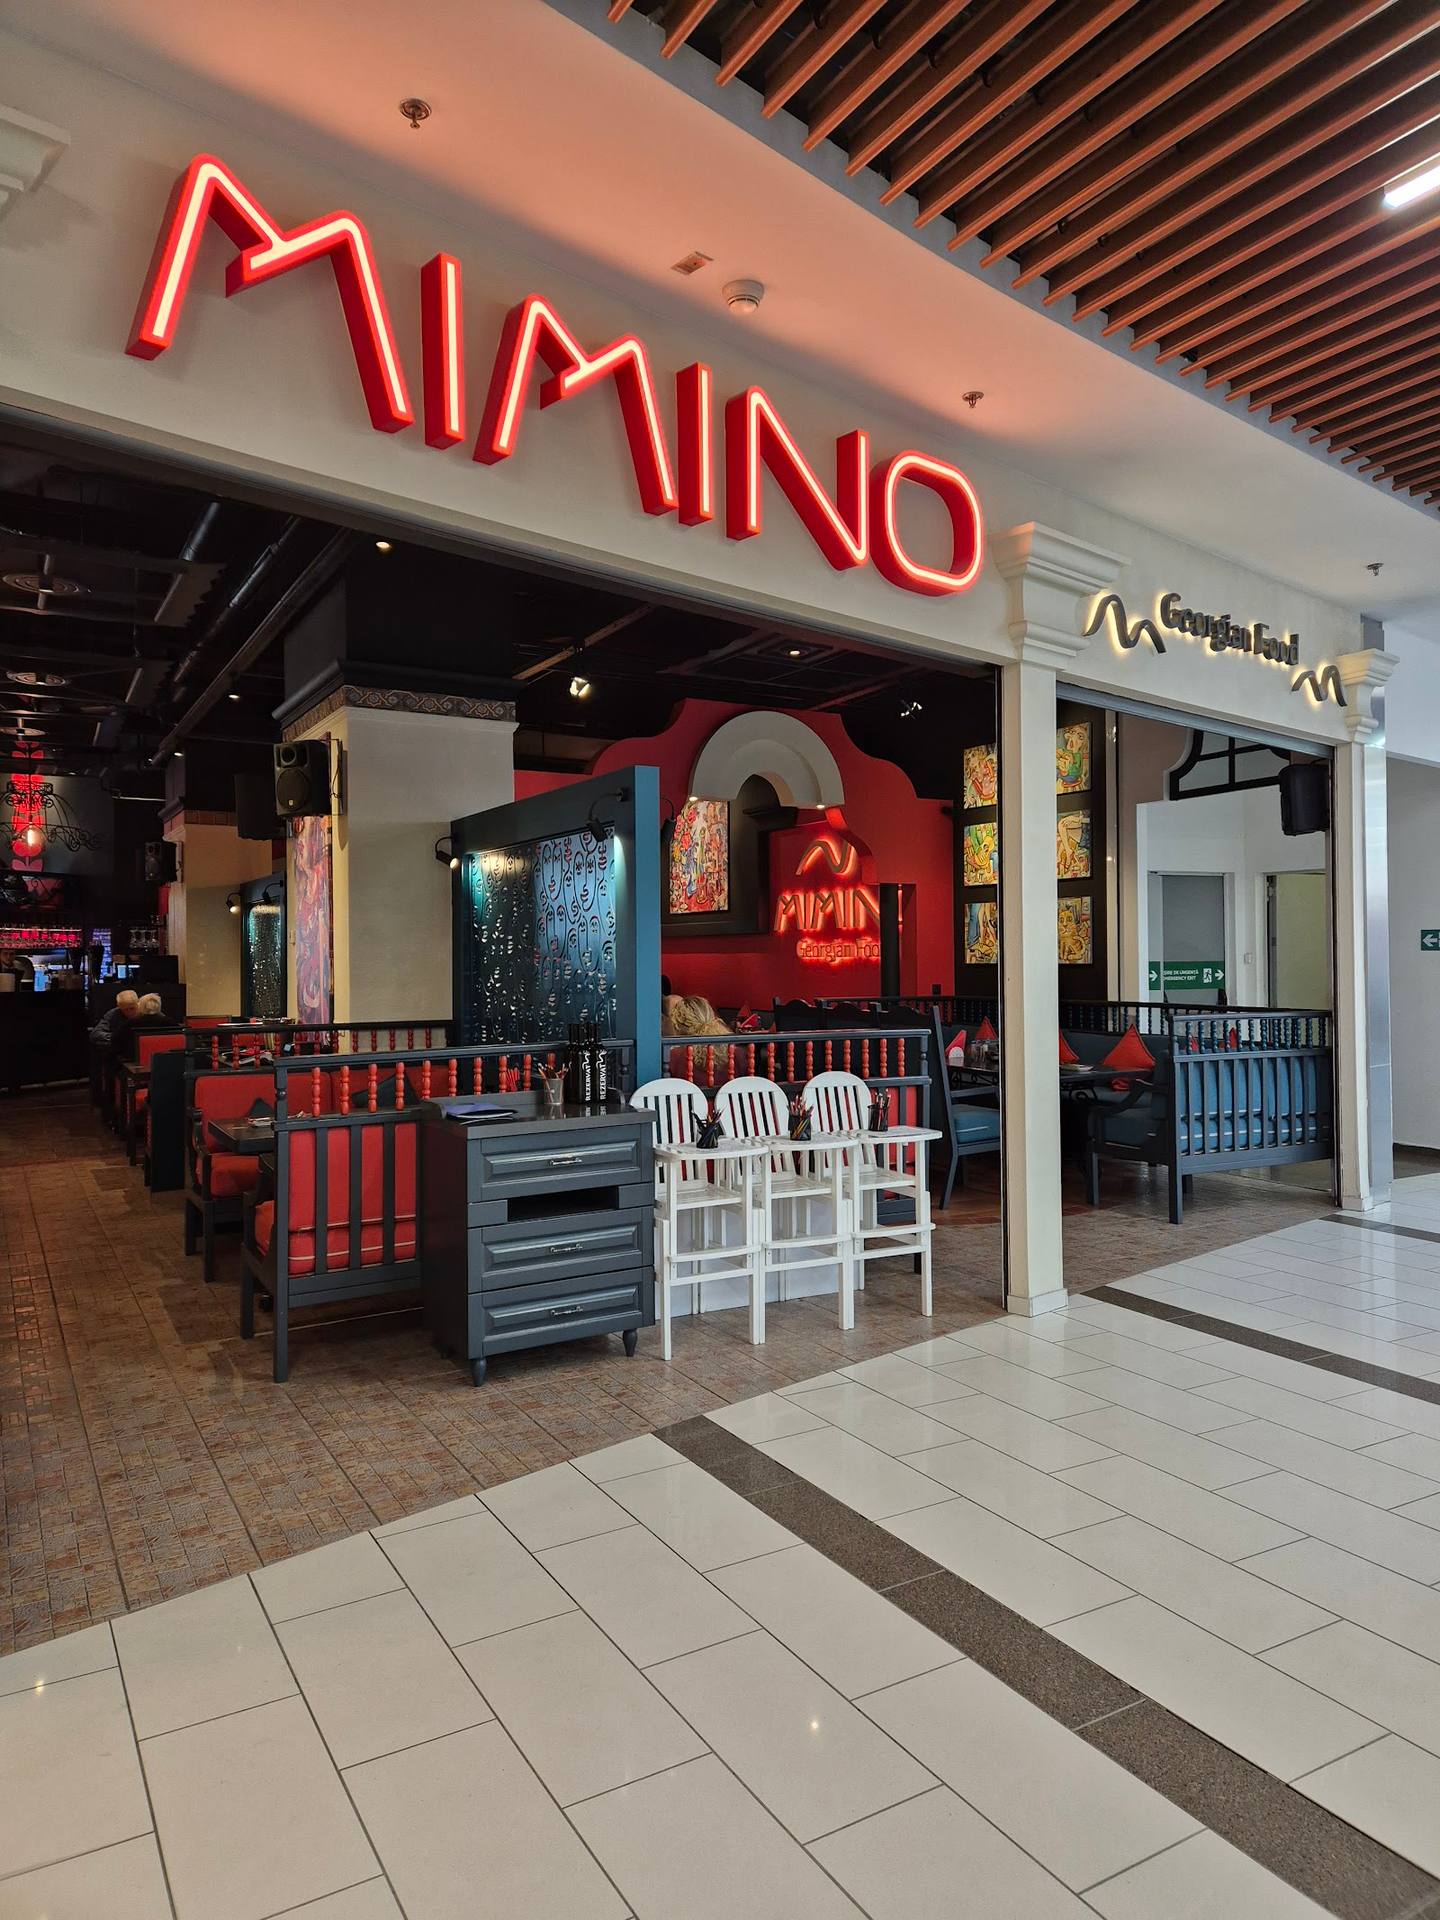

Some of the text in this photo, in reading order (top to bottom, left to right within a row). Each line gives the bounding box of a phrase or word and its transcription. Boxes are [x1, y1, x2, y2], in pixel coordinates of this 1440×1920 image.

[126, 152, 986, 597] MIMINO
[1160, 592, 1300, 666] Georgian Food
[773, 887, 881, 931] MIMIN
[798, 937, 880, 962] Georgian Foo
[599, 1064, 607, 1100] REZERVAT
